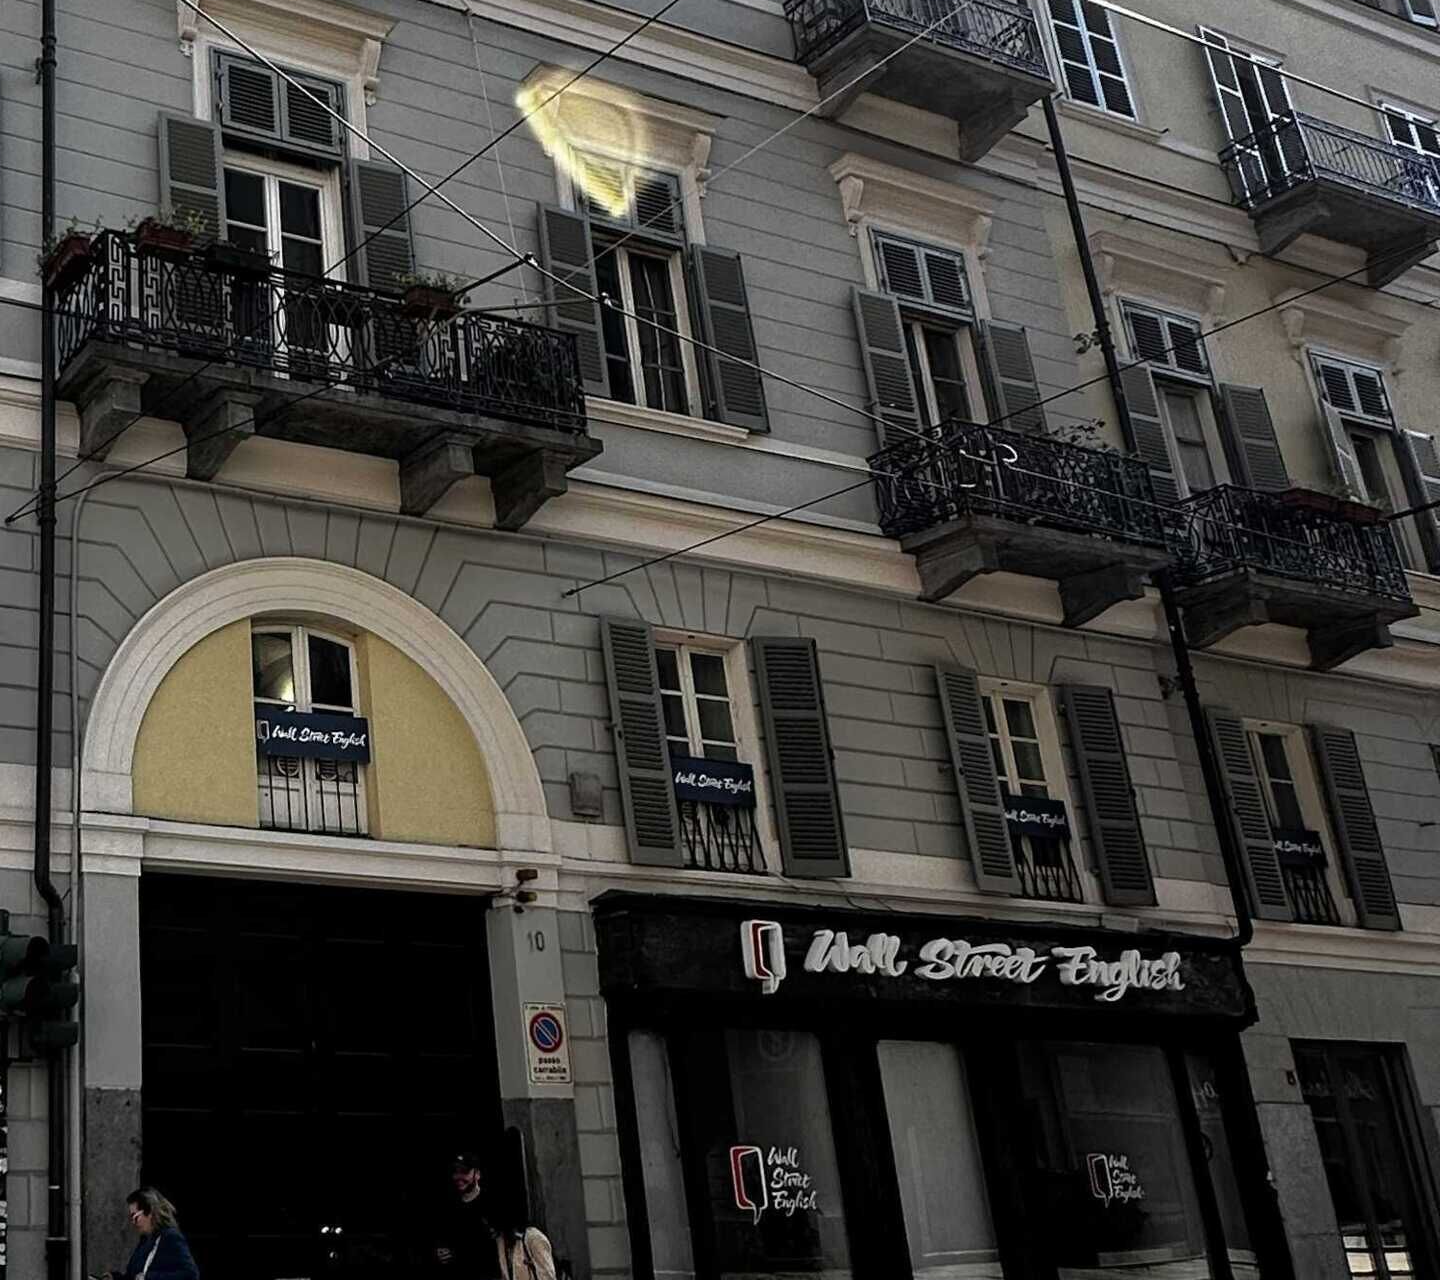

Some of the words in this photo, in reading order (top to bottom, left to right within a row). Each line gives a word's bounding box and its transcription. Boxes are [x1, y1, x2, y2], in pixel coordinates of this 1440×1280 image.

[272, 724, 297, 742] Wall
[298, 727, 330, 744] Street
[331, 731, 366, 749] English
[526, 930, 545, 952] 10
[803, 929, 908, 977] Wall
[914, 937, 1048, 983] Street
[1051, 946, 1186, 1001] English
[767, 1146, 800, 1168] Wall
[770, 1167, 811, 1189] Street
[771, 1189, 817, 1217] English
